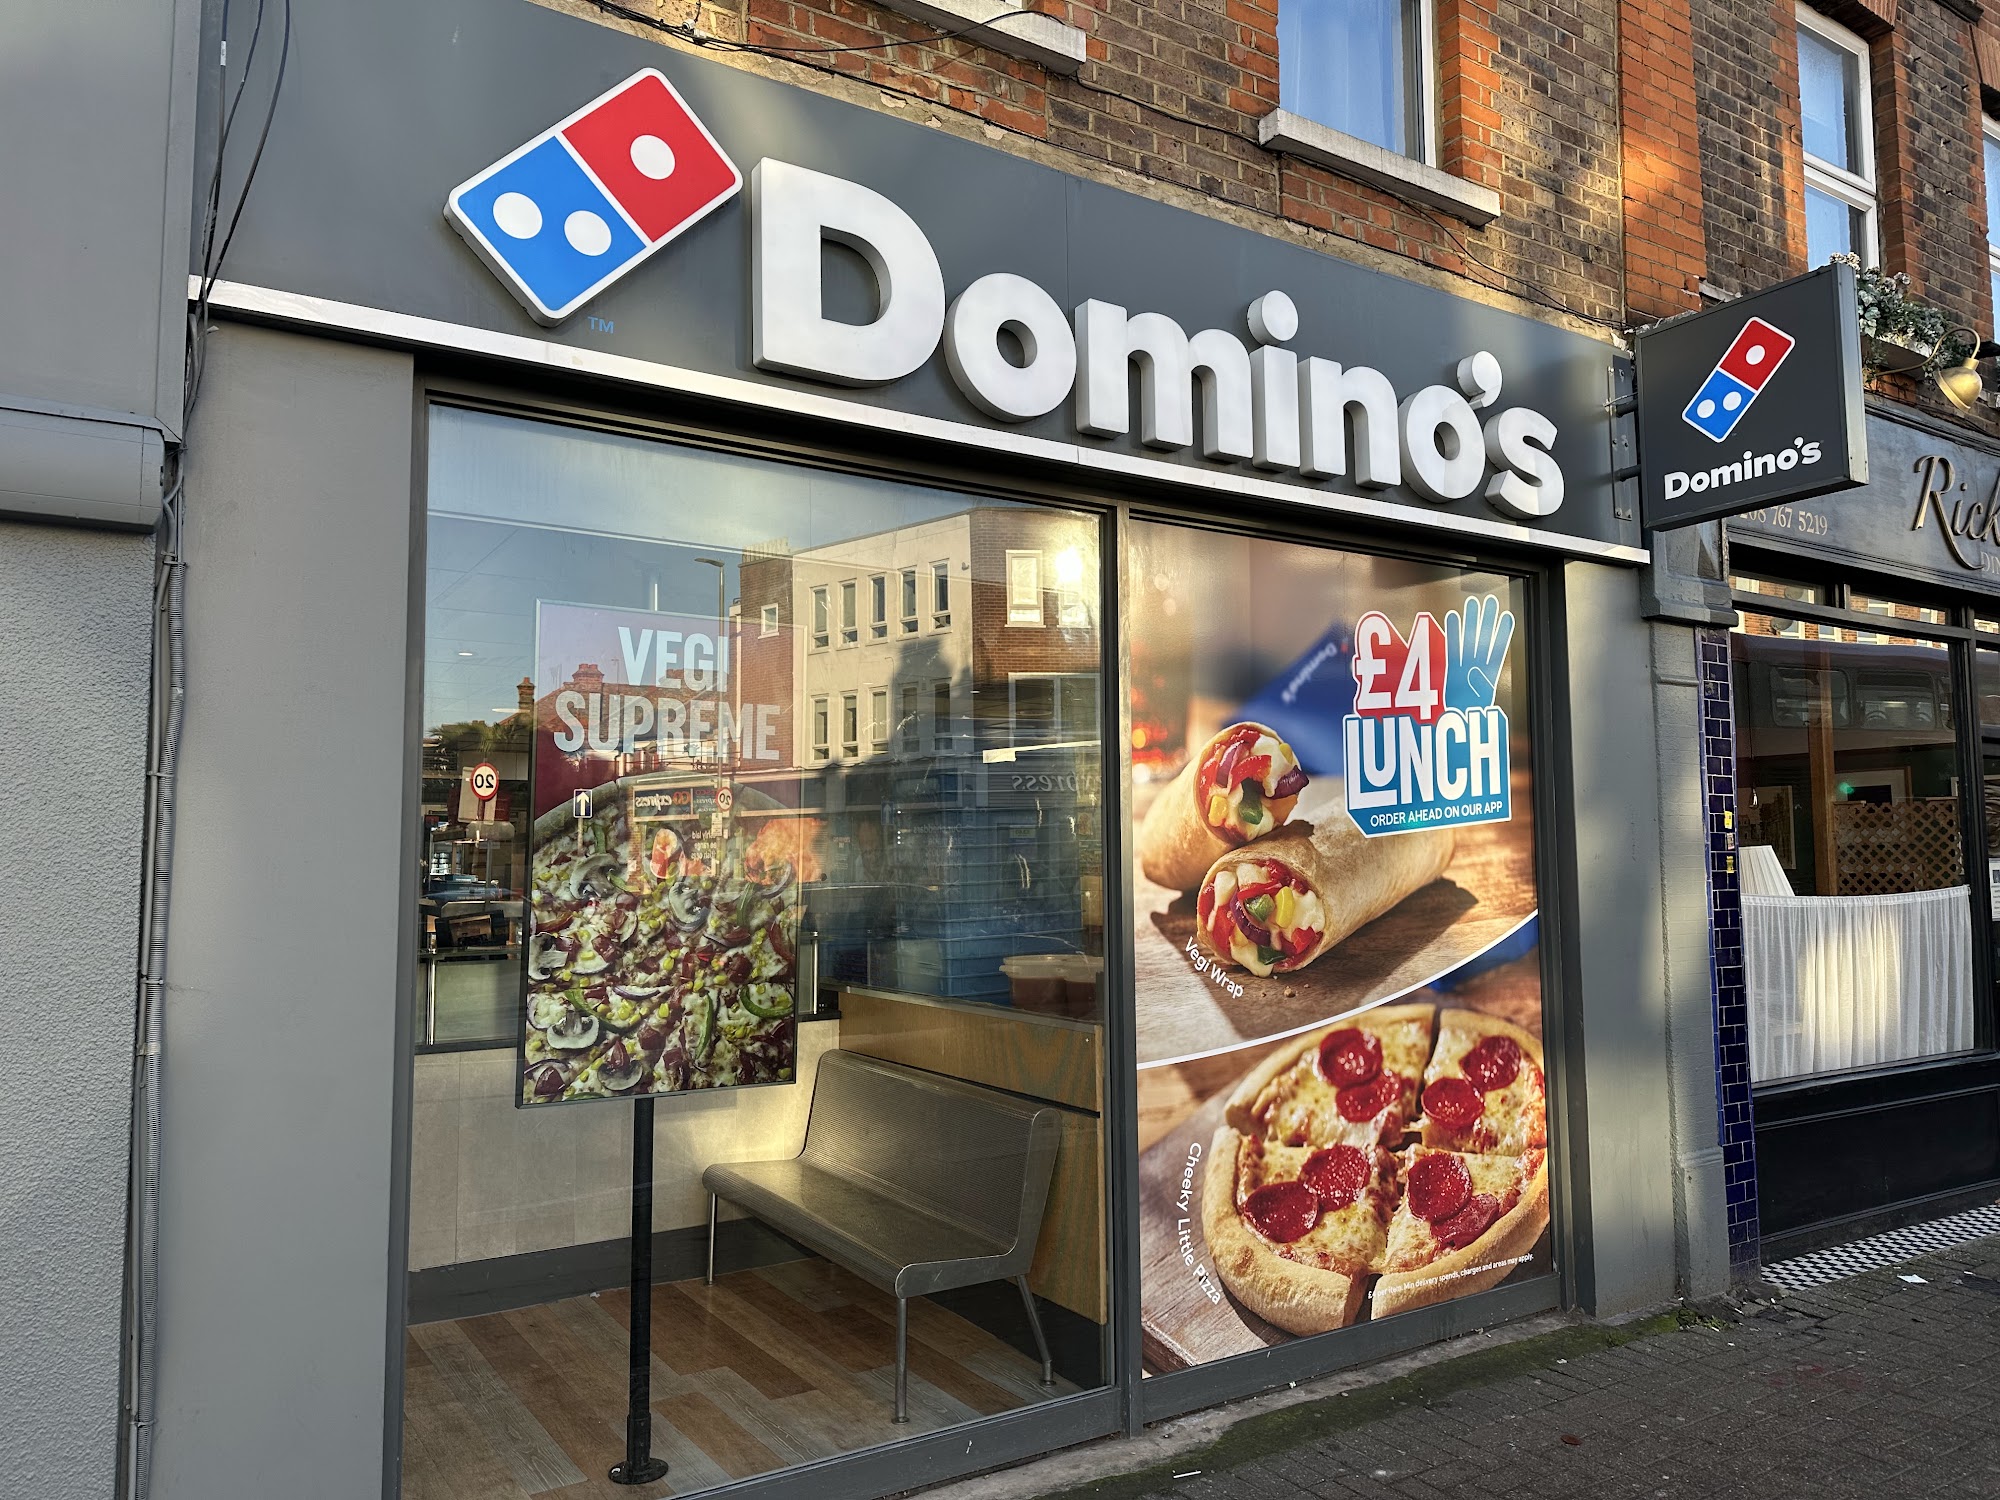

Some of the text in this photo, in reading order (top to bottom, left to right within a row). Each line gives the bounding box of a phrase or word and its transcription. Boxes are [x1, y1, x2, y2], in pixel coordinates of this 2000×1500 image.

[587, 316, 614, 334] TM
[752, 157, 1565, 519] Domino's
[1664, 436, 1823, 500] Domino's
[1771, 506, 1793, 528] 767
[1798, 511, 1828, 536] 5219
[618, 626, 730, 693] VEGI
[1356, 616, 1439, 720] £4
[553, 690, 782, 761] SUPREME
[1347, 709, 1502, 811] LUNCH
[1370, 801, 1503, 827] ORDER AHEAD ON OUR APP
[1185, 936, 1245, 999] Vegi Wrap
[1176, 1142, 1221, 1305] Cheeky Little Pizza
[1378, 1289, 1387, 1298] per
[1403, 1281, 1415, 1291] Min
[1415, 1276, 1439, 1288] delivery
[1439, 1270, 1460, 1282] spends,
[1460, 1265, 1481, 1276] charges
[1481, 1261, 1492, 1271] and
[1492, 1259, 1507, 1269] areas
[1507, 1256, 1519, 1267] may
[1519, 1252, 1534, 1264] apply.
